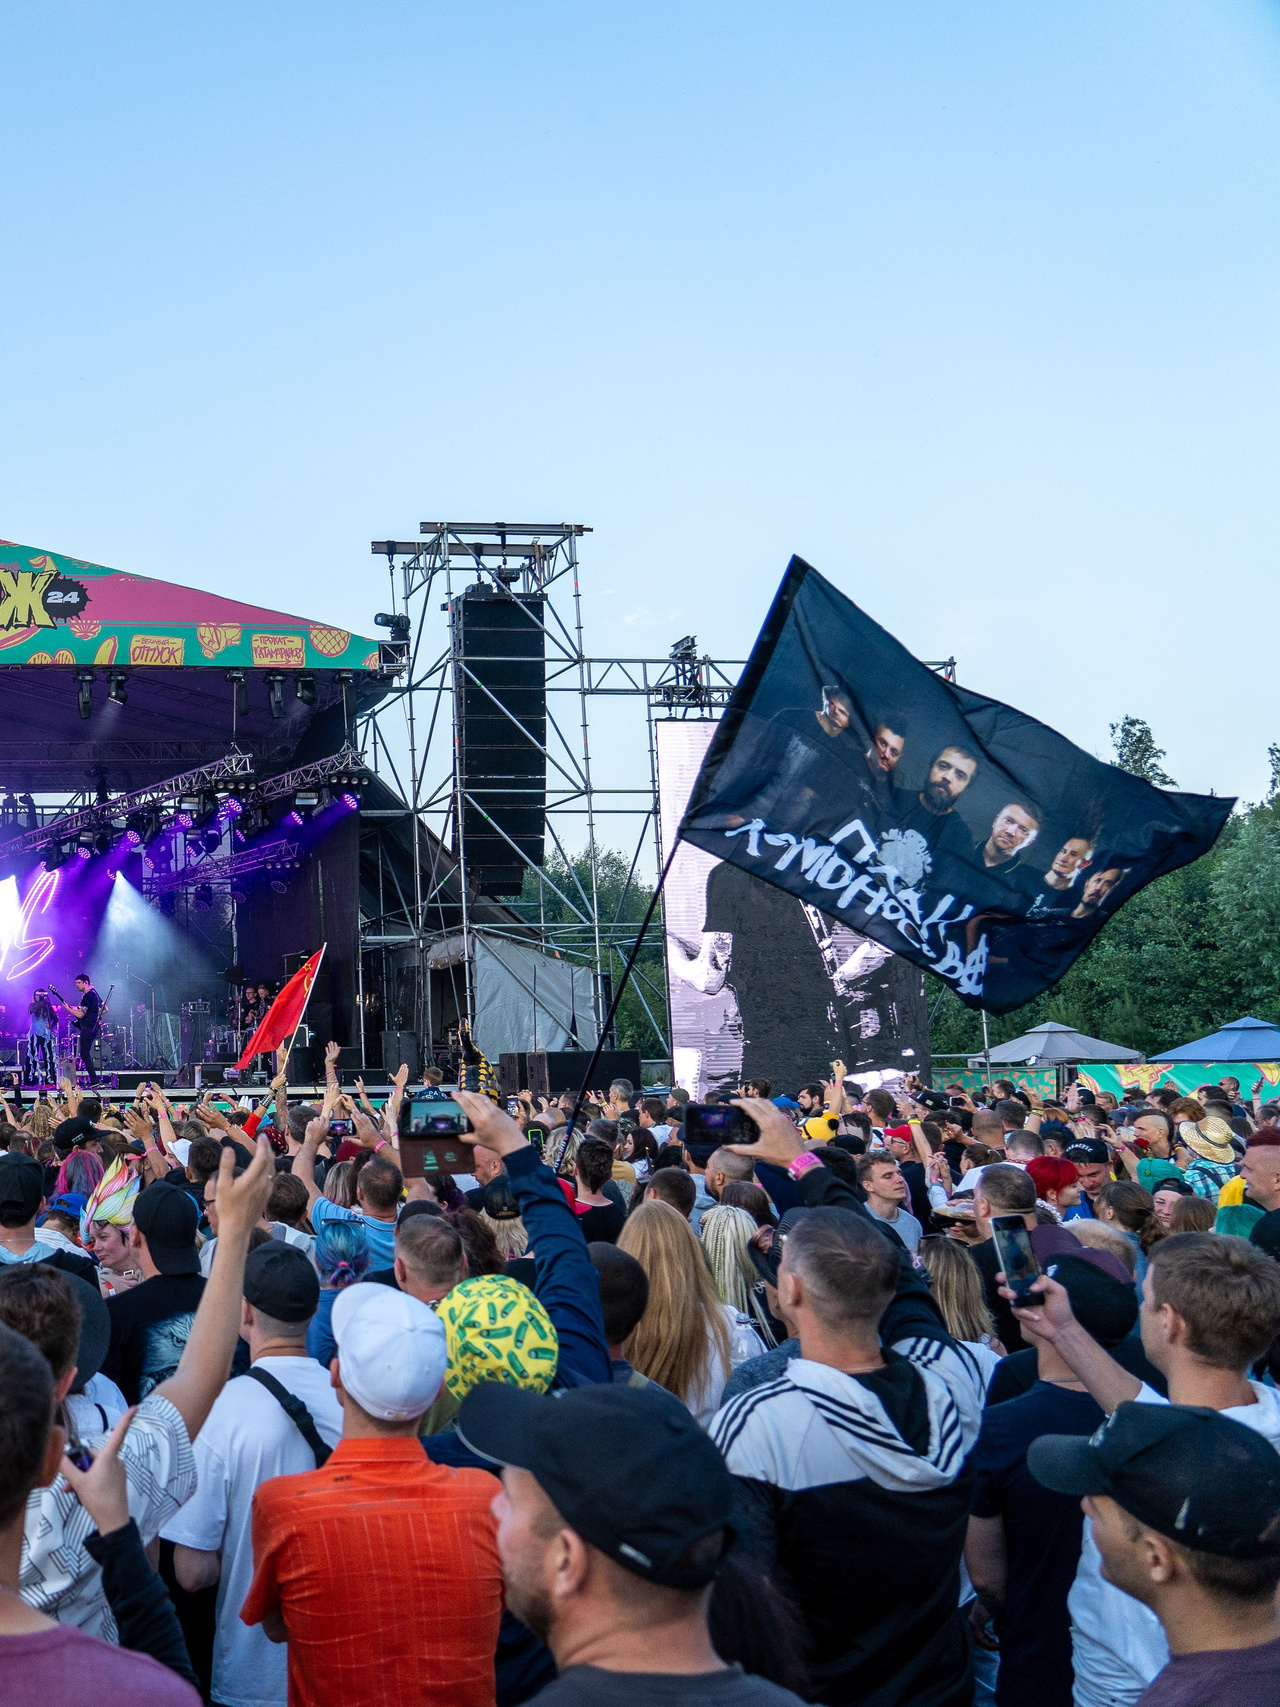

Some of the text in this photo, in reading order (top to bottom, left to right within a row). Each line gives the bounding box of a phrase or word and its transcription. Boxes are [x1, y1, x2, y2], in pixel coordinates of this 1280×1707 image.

[46, 591, 80, 604] 24
[259, 636, 287, 646] ПРОКАТ
[131, 645, 182, 665] ОТПУСК
[254, 647, 303, 659] КАТАМАРАНОВ
